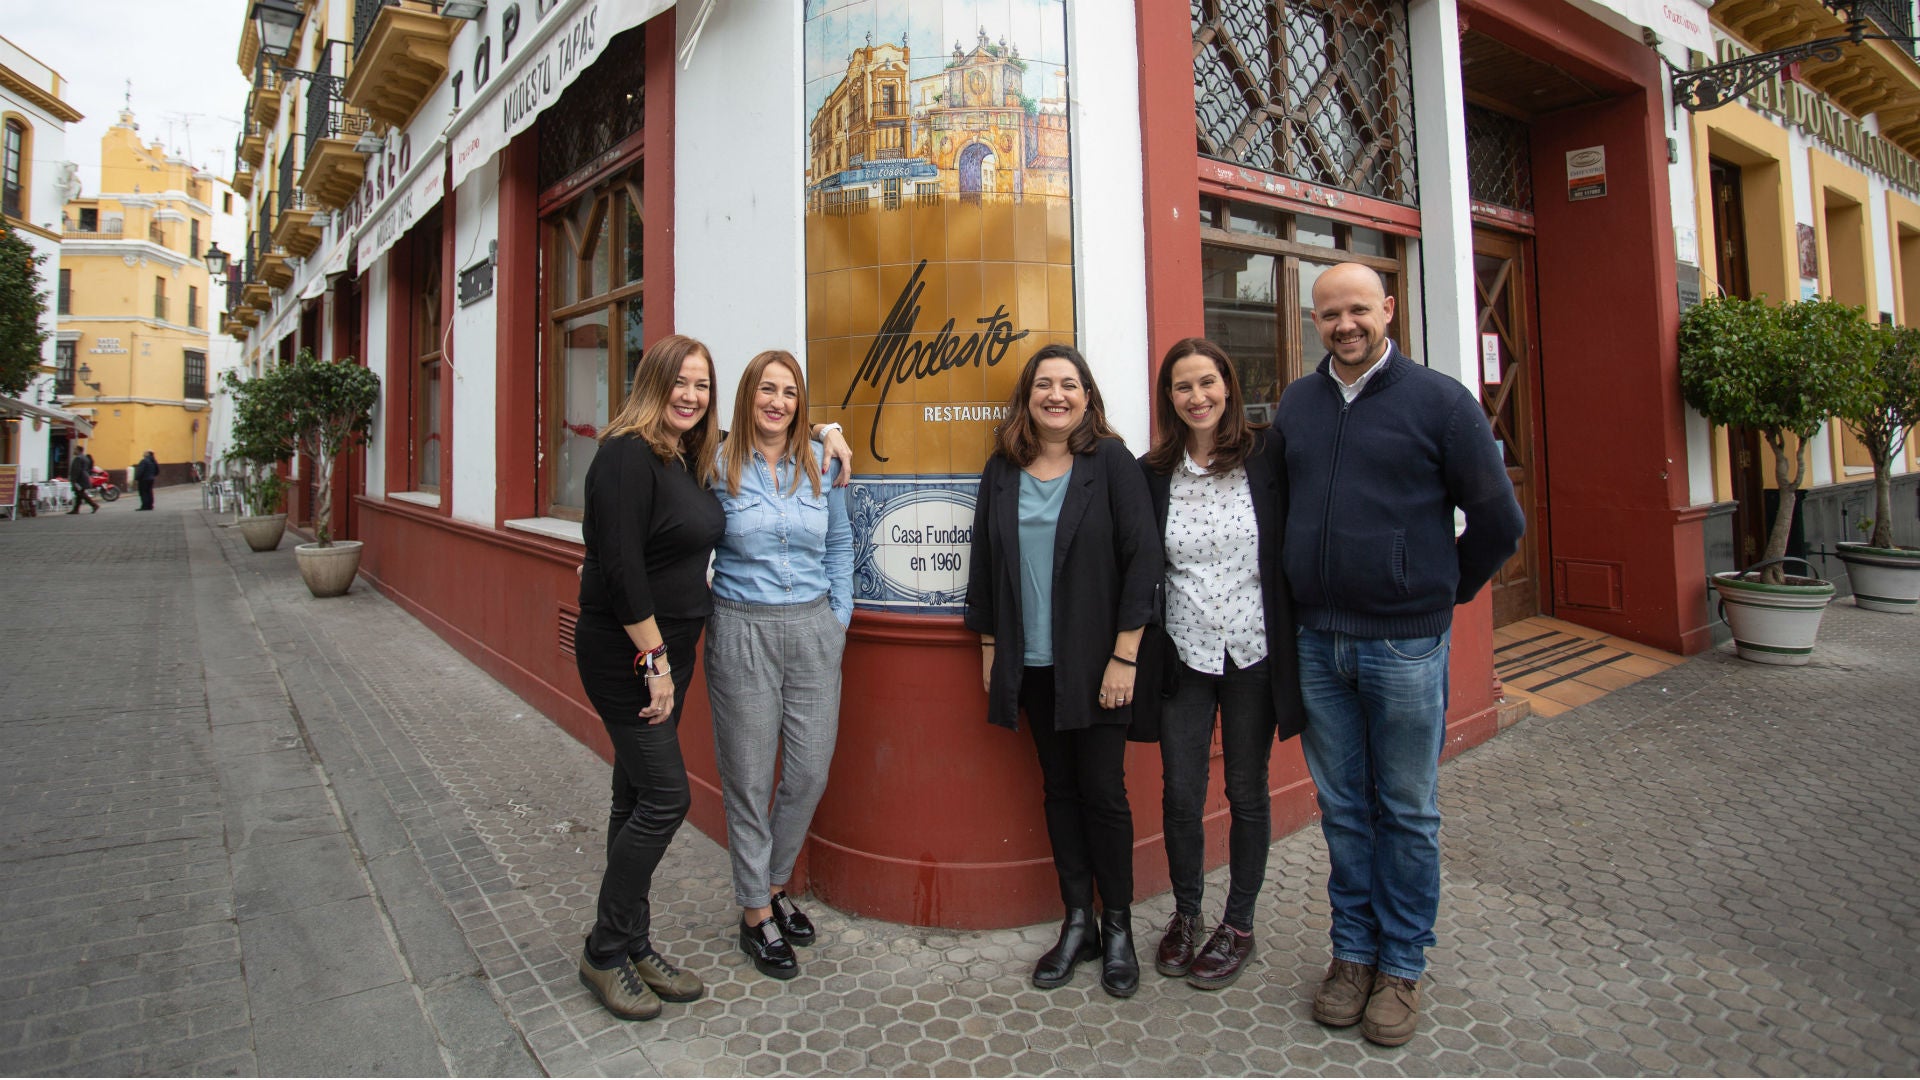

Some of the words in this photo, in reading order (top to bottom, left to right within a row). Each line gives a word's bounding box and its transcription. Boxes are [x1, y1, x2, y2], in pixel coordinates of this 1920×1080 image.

[503, 54, 550, 133] MODESTO
[558, 4, 598, 81] TAPAS
[841, 259, 1029, 462] Modesto
[892, 525, 922, 543] Casa
[910, 557, 926, 571] en
[931, 553, 961, 571] 1960
